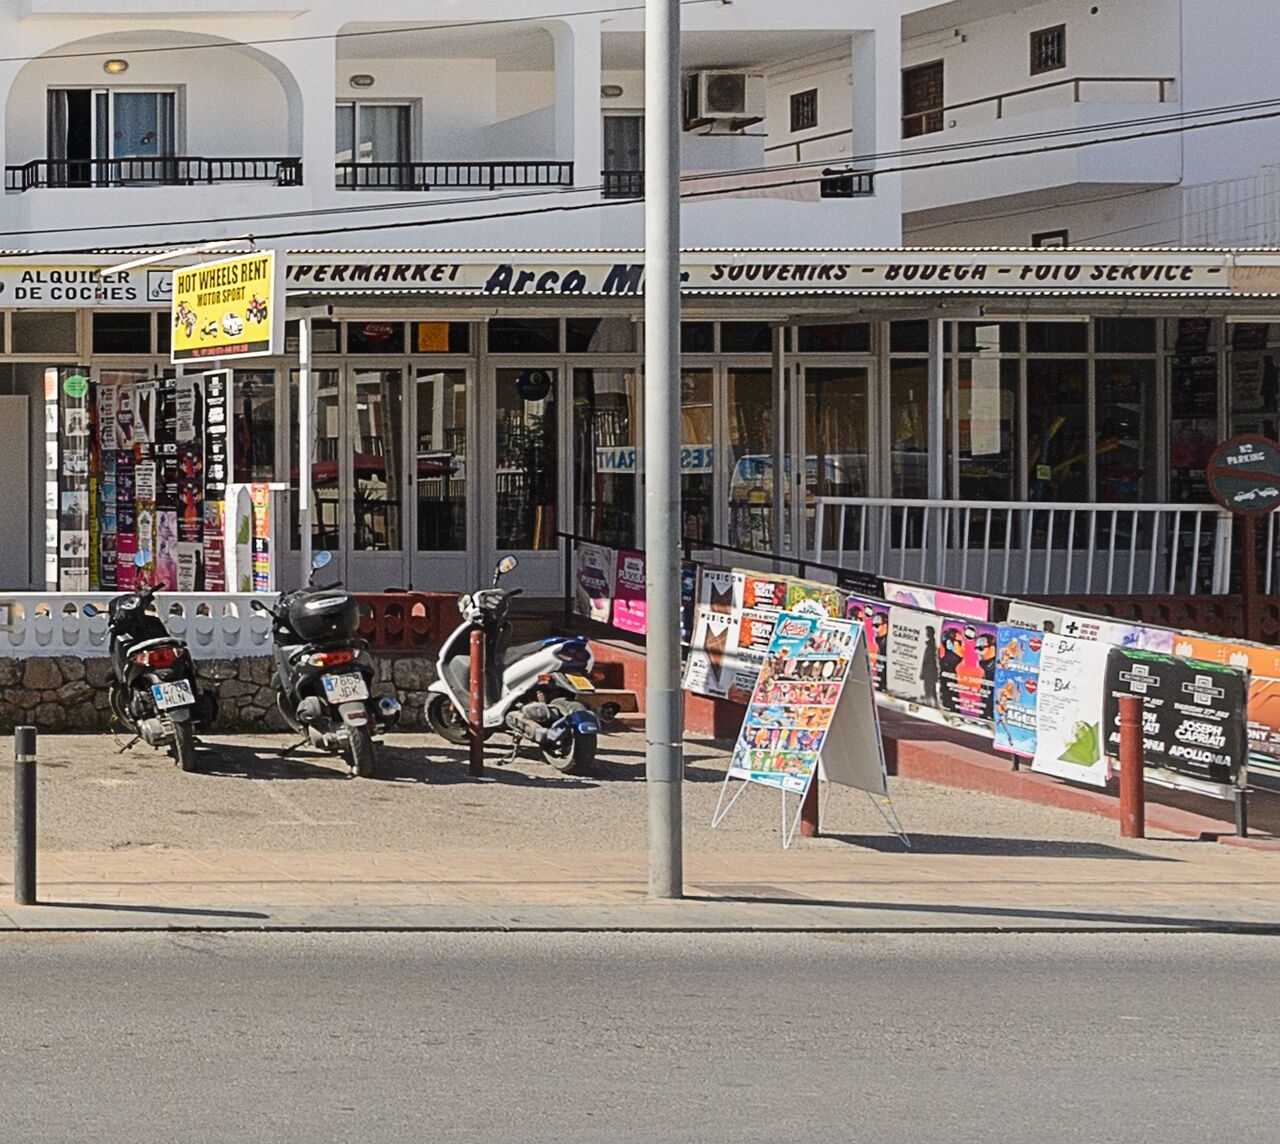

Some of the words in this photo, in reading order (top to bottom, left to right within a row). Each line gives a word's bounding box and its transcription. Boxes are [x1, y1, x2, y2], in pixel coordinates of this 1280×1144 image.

[21, 270, 131, 284] ALQUILER
[177, 272, 197, 295] HOT
[198, 264, 239, 290] WHEELS
[240, 259, 268, 283] RENT
[884, 264, 988, 282] BODEGA
[1088, 265, 1195, 282] SERVICE
[15, 287, 43, 300] DE
[50, 287, 138, 301] COCHES
[197, 290, 221, 308] MOTOR
[222, 286, 246, 304] SPORT
[1226, 451, 1266, 467] PARKING
[164, 693, 187, 706] HLN
[1179, 720, 1224, 737] JOSEPH
[1174, 728, 1227, 748] CAPRIATI
[1168, 745, 1232, 767] APOLLONIA
